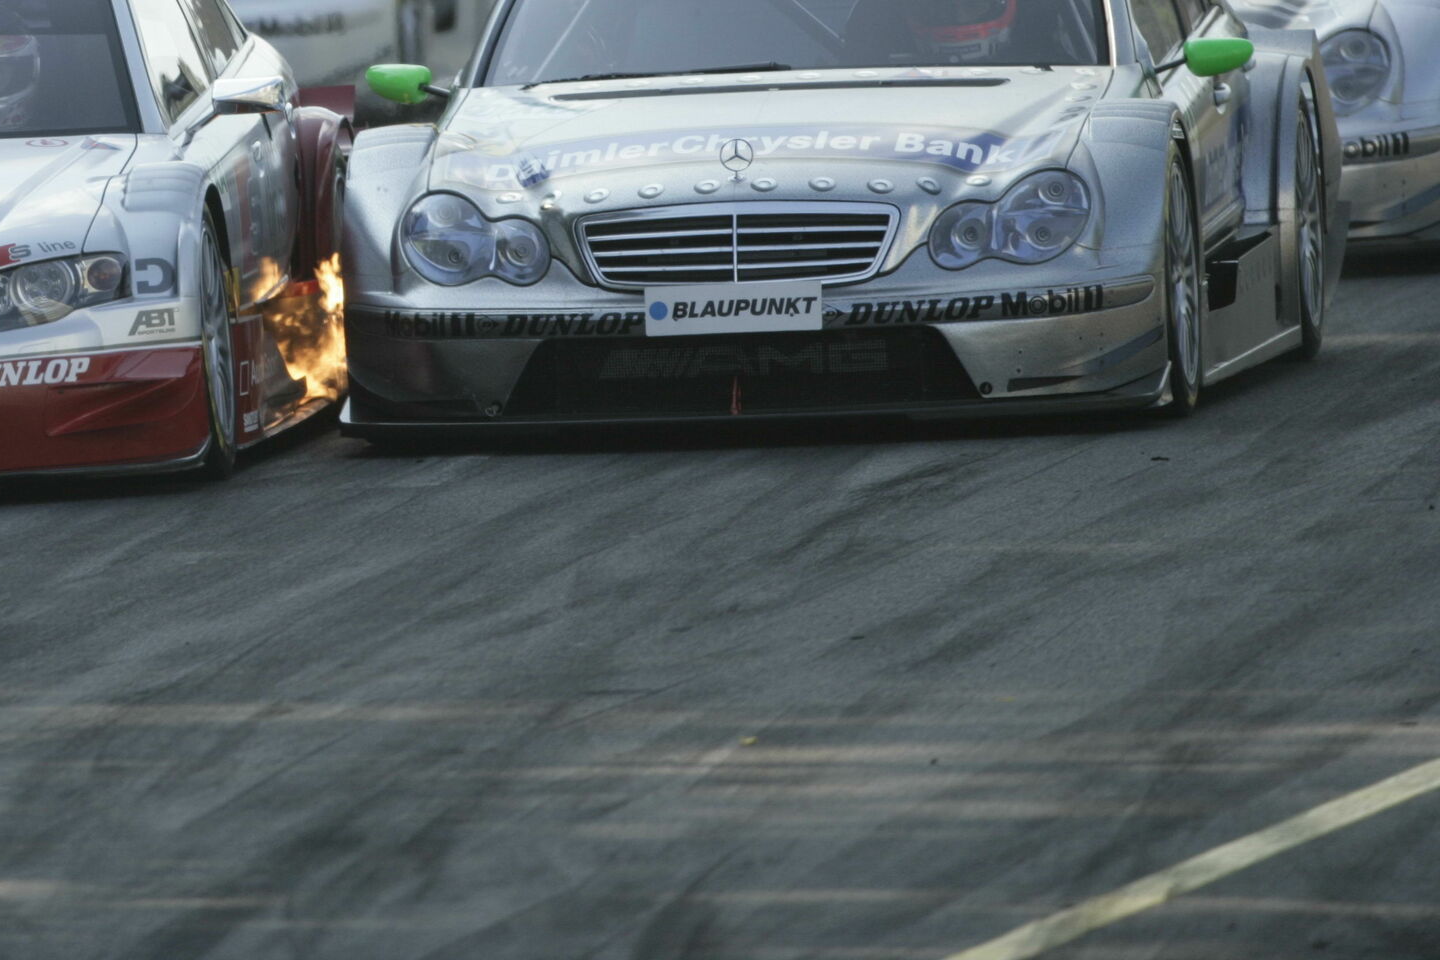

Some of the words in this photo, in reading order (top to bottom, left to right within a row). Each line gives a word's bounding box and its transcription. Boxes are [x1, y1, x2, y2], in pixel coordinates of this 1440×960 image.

[894, 132, 1015, 166] Bank
[1343, 133, 1389, 158] obil
[37, 240, 77, 254] line
[672, 296, 818, 321] BLAUPUNKT
[845, 294, 994, 325] DUNLOP
[1001, 287, 1080, 317] Mobil
[128, 308, 176, 337] ABT
[501, 311, 646, 337] DUNLOP
